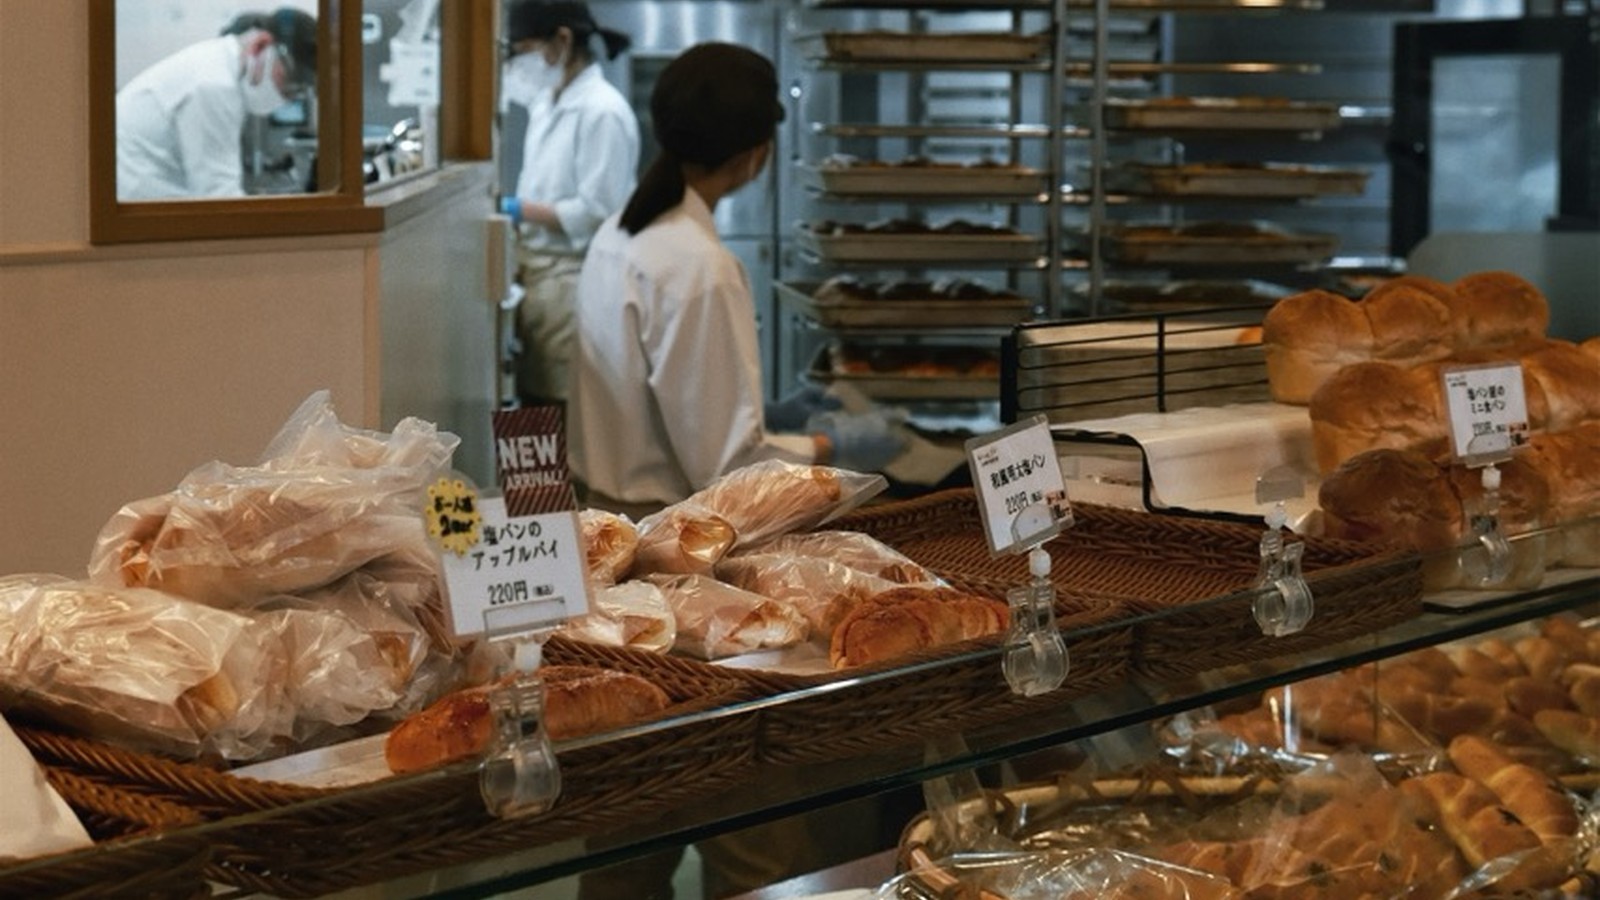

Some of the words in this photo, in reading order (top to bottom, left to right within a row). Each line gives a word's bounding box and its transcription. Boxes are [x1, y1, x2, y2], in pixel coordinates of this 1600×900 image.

[498, 433, 557, 470] NEW
[506, 469, 564, 491] ARRIVAL!
[482, 520, 542, 546] 塩パンの
[472, 539, 558, 571] アップルパイ
[487, 580, 529, 606] 220円
